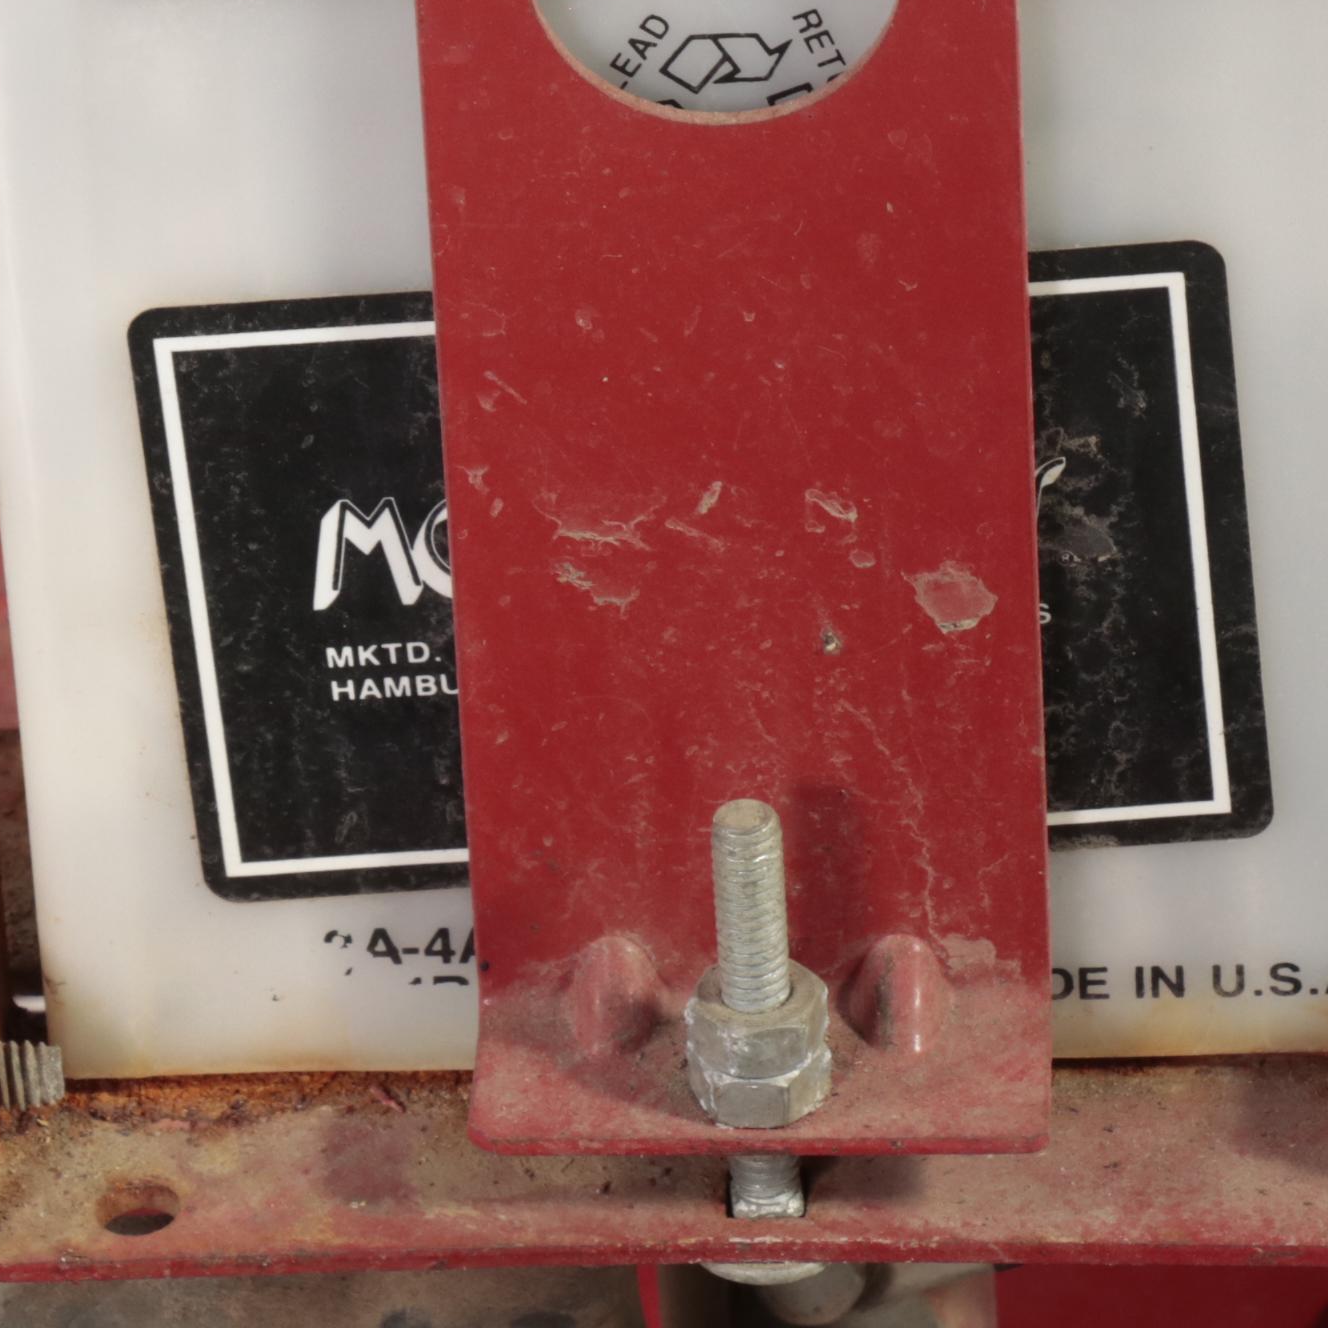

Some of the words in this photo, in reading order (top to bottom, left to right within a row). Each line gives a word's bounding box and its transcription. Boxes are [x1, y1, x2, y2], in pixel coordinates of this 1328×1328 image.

[609, 14, 670, 86] EAD
[791, 8, 847, 83] RET
[325, 641, 442, 669] MKTD.
[1135, 965, 1186, 999] IN
